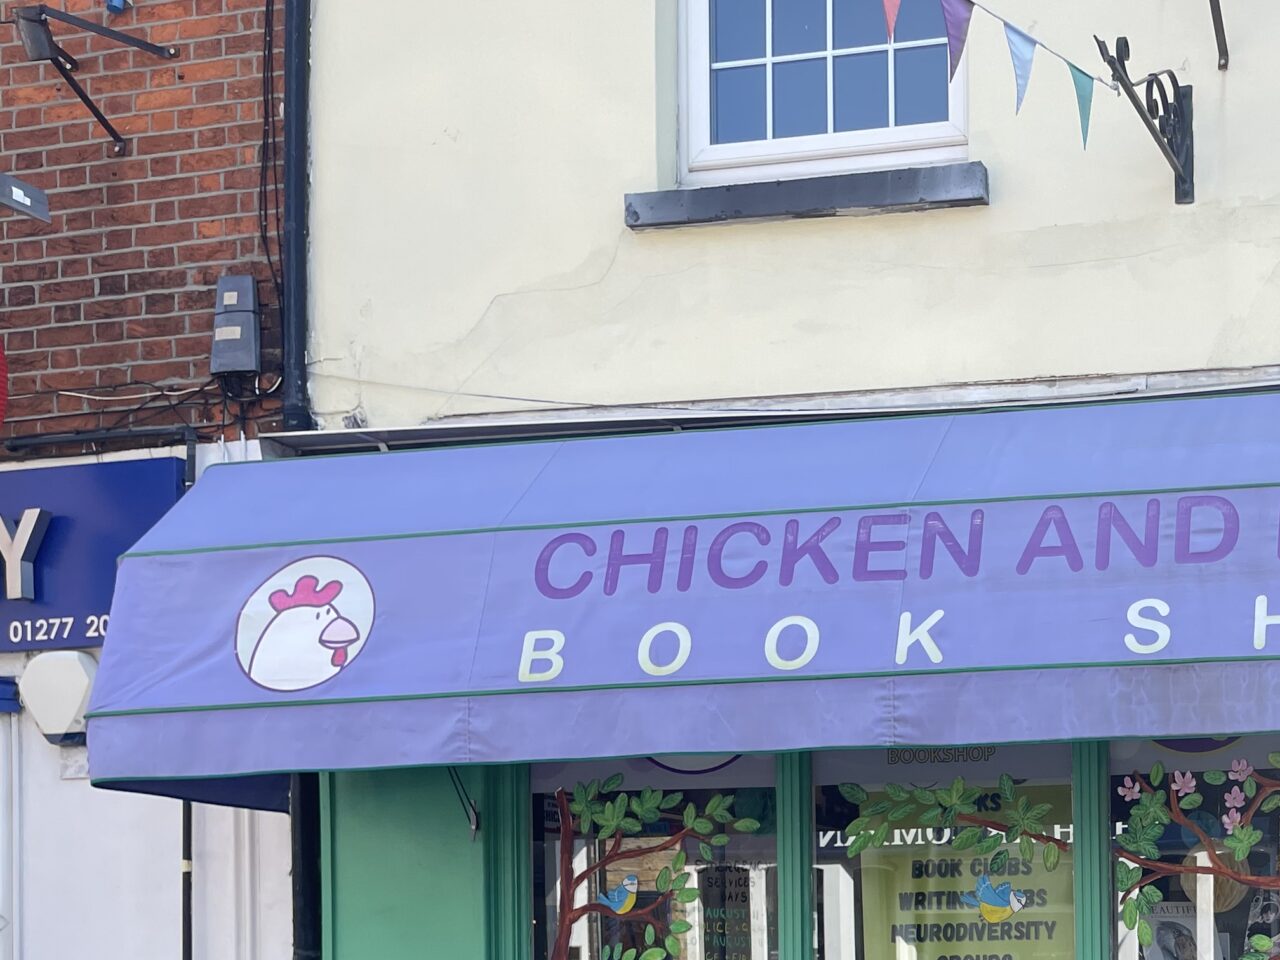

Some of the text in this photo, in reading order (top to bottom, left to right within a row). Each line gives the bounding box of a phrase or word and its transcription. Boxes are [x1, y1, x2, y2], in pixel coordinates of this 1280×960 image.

[534, 508, 984, 600] CHICKEN
[1016, 495, 1240, 576] AND
[9, 617, 74, 643] 01277
[518, 609, 944, 682] BOOK
[887, 745, 997, 765] BOOKSHOP
[911, 859, 962, 879] BOOK
[890, 920, 1056, 943] NEURODIVERSITY
